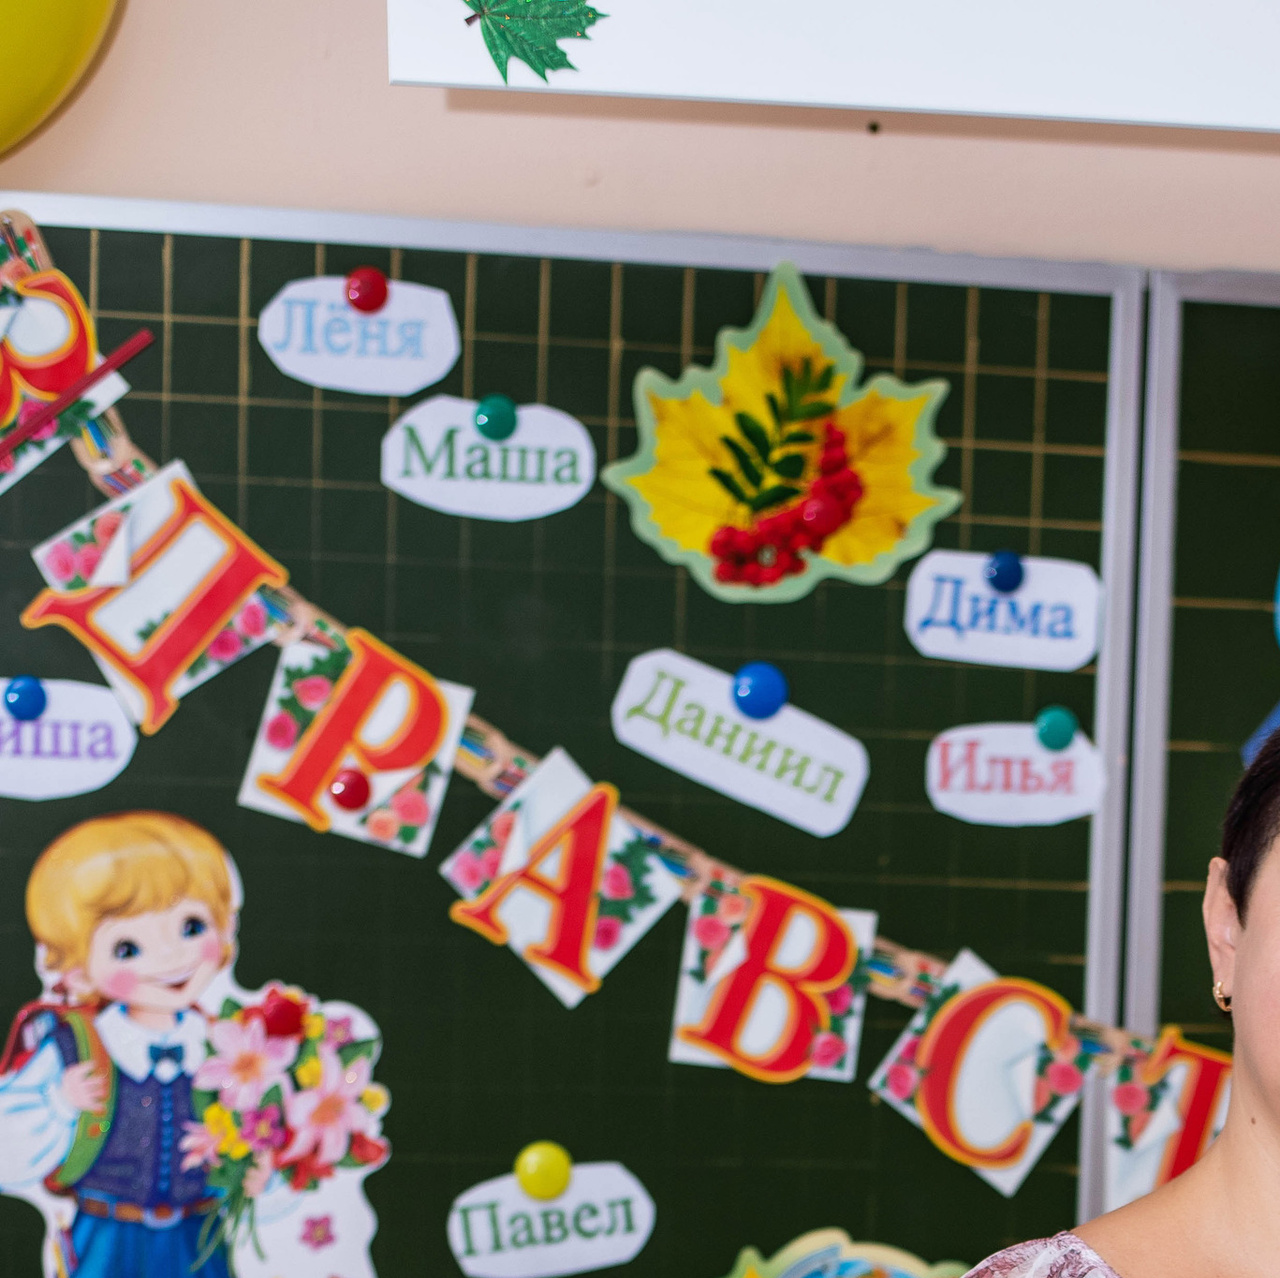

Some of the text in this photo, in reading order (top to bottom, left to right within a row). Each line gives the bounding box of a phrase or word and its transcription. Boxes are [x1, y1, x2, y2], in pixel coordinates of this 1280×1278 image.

[272, 296, 426, 360] Лёня
[400, 425, 582, 485] Маша
[917, 575, 1078, 642] Дима
[624, 670, 846, 806] Даниил
[936, 739, 1078, 796] Илья
[457, 1196, 637, 1256] Павел
